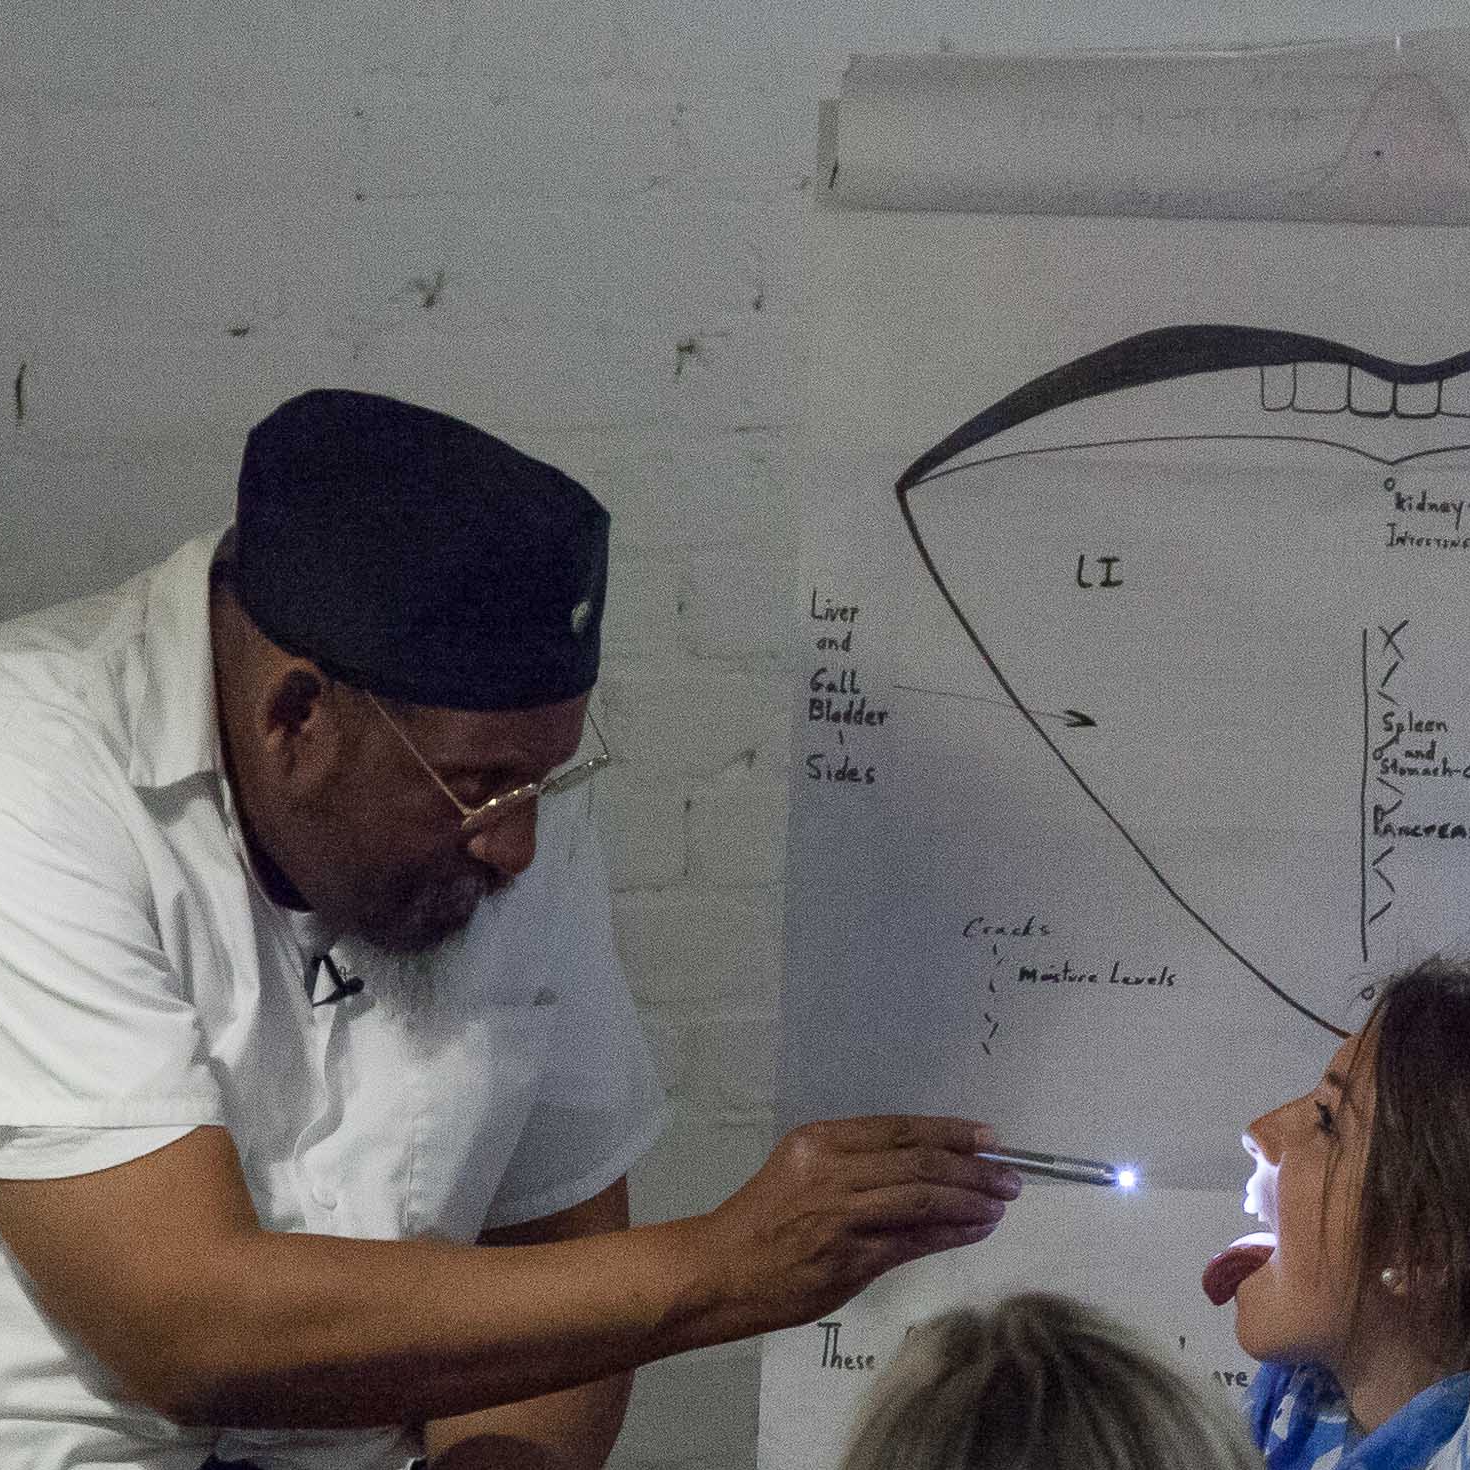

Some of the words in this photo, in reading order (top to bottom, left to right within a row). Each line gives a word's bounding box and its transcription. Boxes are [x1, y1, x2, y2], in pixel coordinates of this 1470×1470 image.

[1077, 554, 1123, 588] LI
[812, 588, 860, 622] Liver
[817, 631, 852, 651] and
[810, 668, 860, 694] Gall
[809, 697, 888, 726] Bladder
[1382, 710, 1448, 743] Spleen
[1405, 739, 1437, 760] and
[806, 754, 875, 784] Sides
[962, 915, 1050, 938] Cracks
[1109, 961, 1177, 987] Levels
[817, 1321, 875, 1370] These
